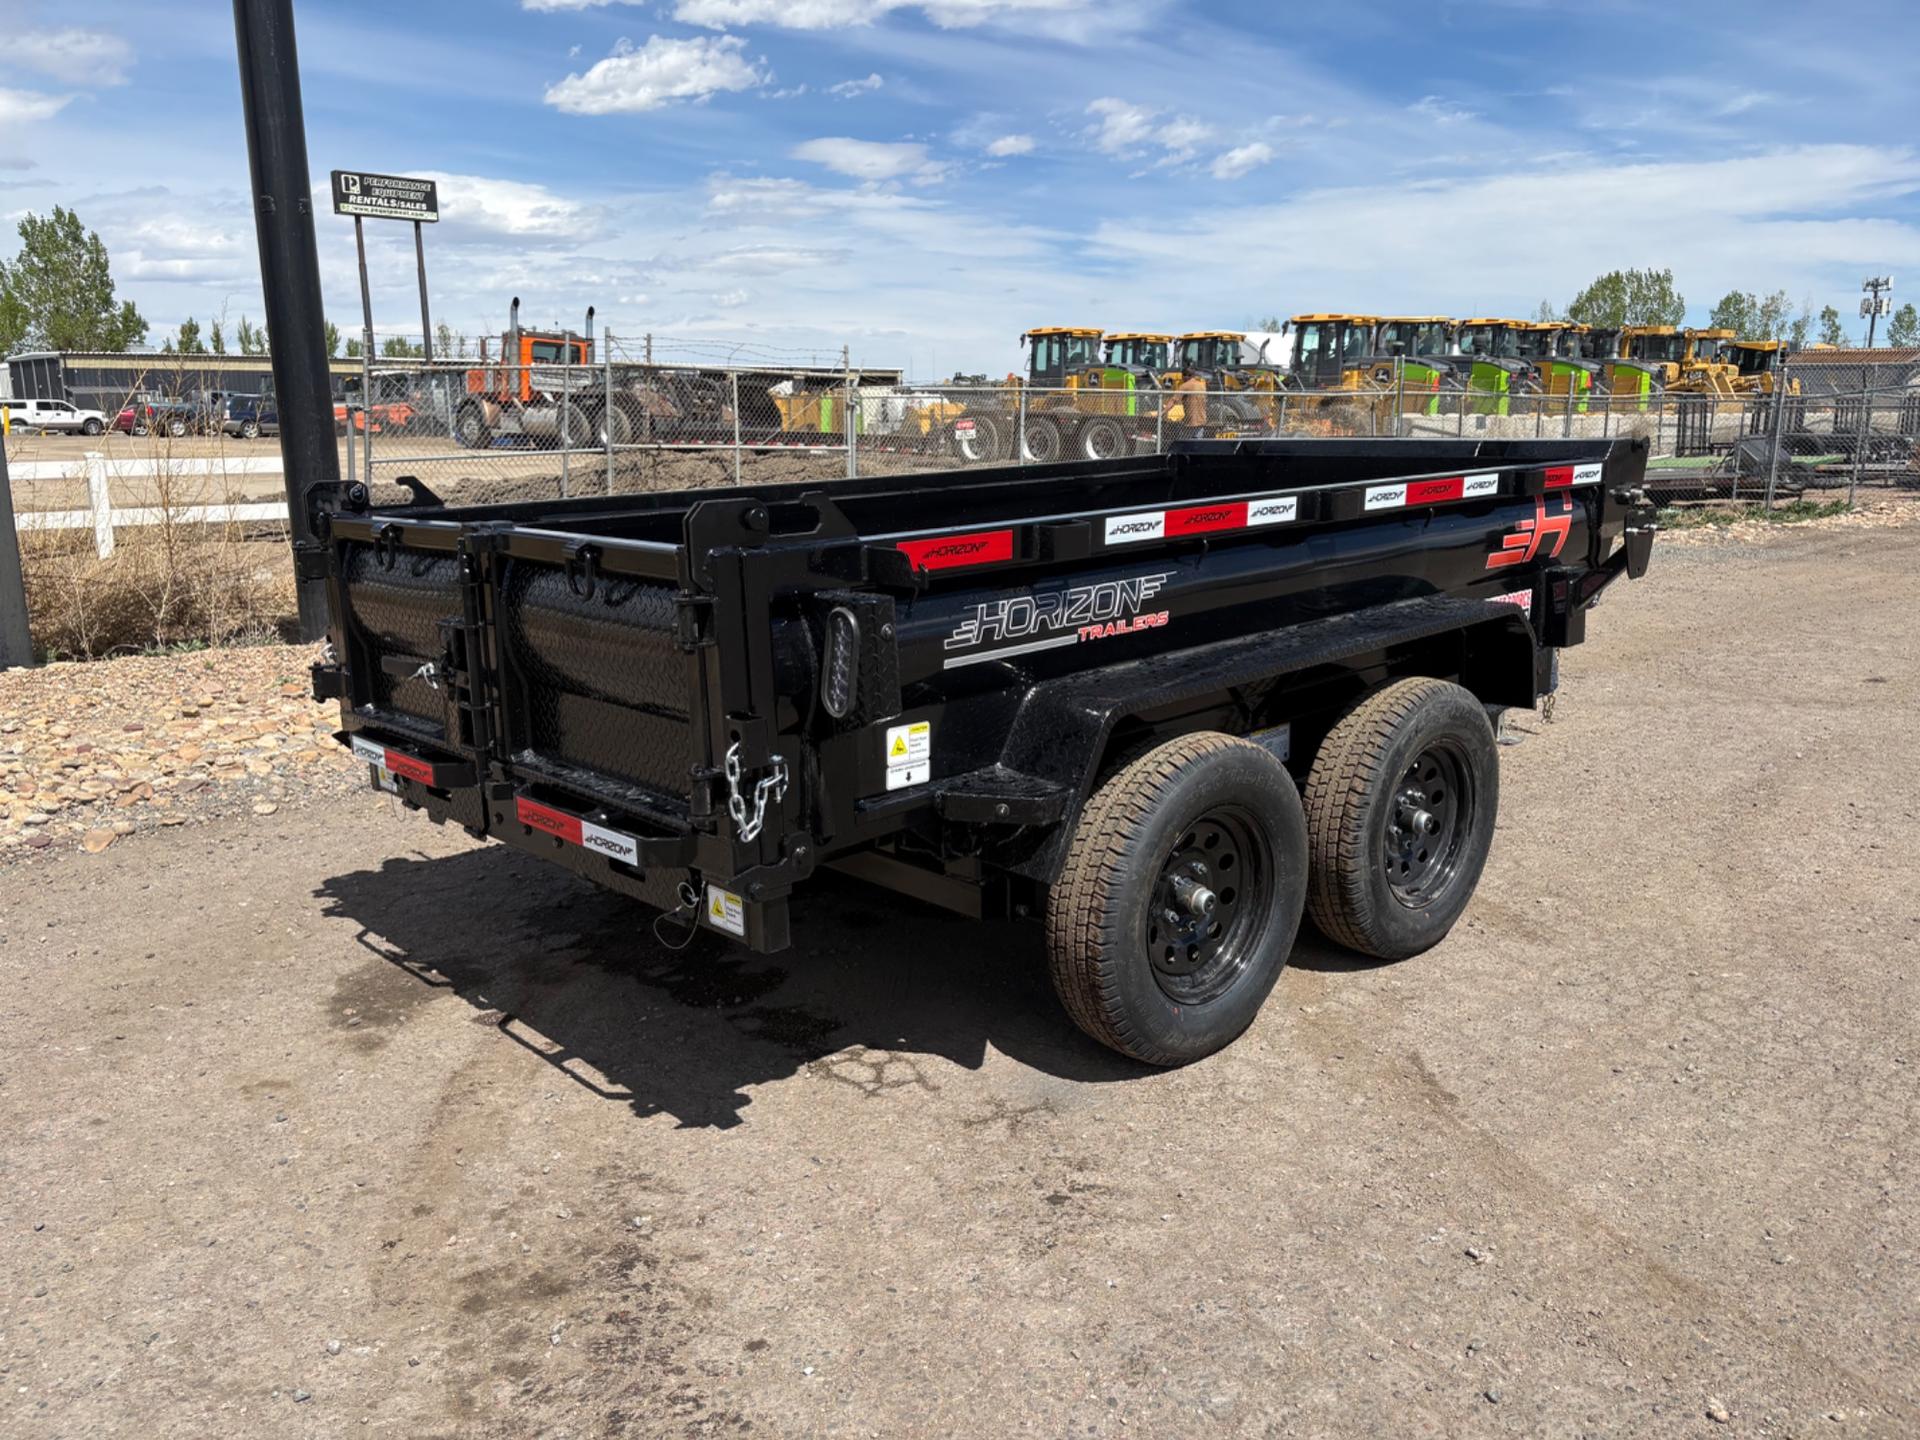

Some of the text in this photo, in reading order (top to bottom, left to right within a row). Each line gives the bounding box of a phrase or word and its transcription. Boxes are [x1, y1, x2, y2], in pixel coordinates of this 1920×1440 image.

[363, 176, 432, 192] PERFORMANCE
[348, 194, 428, 211] RENTALS/SALES
[371, 187, 426, 201] EQUIPMENT
[1184, 510, 1233, 525] HORIZON
[1250, 503, 1296, 518] HORIZON
[1109, 519, 1163, 536] HORIZON
[923, 541, 989, 559] HORIZON
[944, 574, 1168, 649] HORIZON
[1077, 610, 1170, 642] TRAILERS
[585, 833, 634, 856] HORIZON
